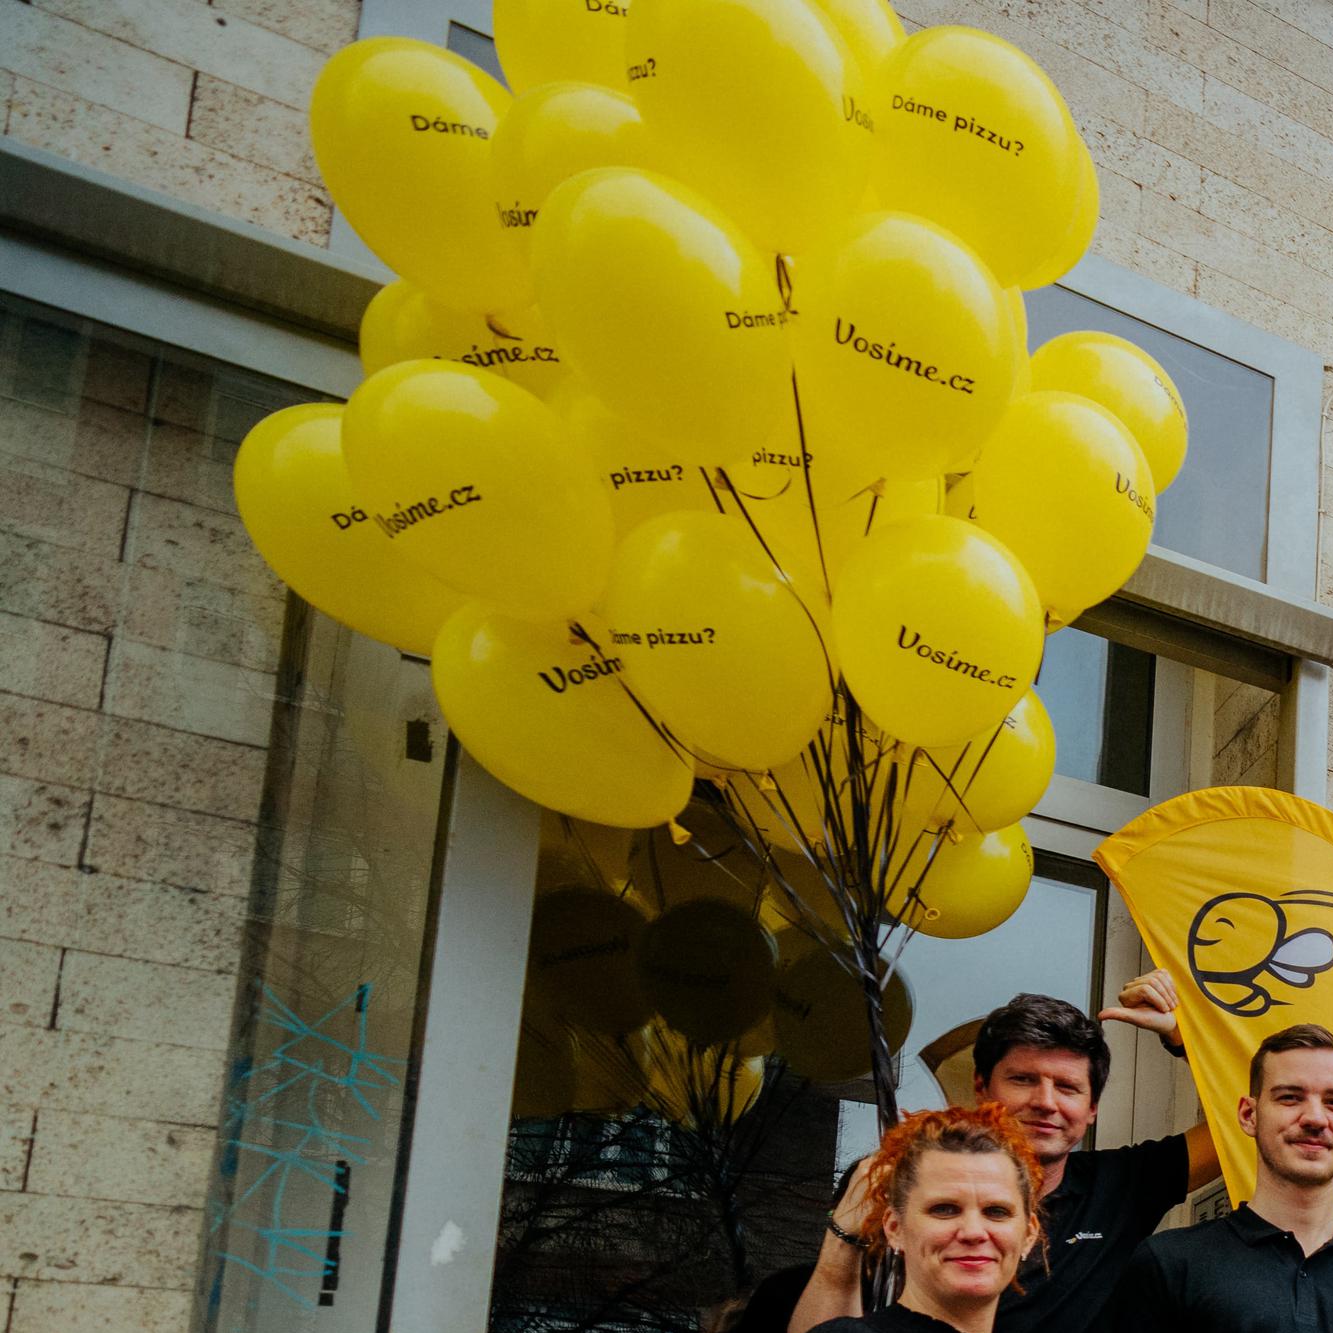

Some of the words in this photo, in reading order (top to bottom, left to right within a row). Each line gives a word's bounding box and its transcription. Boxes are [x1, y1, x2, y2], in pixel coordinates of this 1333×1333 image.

[410, 114, 489, 140] Dáme
[892, 94, 948, 124] Dáme
[954, 115, 1024, 157] pizzu?
[725, 311, 775, 330] Dáme
[433, 343, 560, 369] síme.cz
[834, 318, 975, 395] Vosíme.cz
[610, 465, 684, 489] pizzu?
[331, 506, 368, 531] Dá
[646, 627, 716, 649] pizzu?
[897, 625, 1016, 689] Vosíme.cz
[537, 653, 624, 694] Vosím
